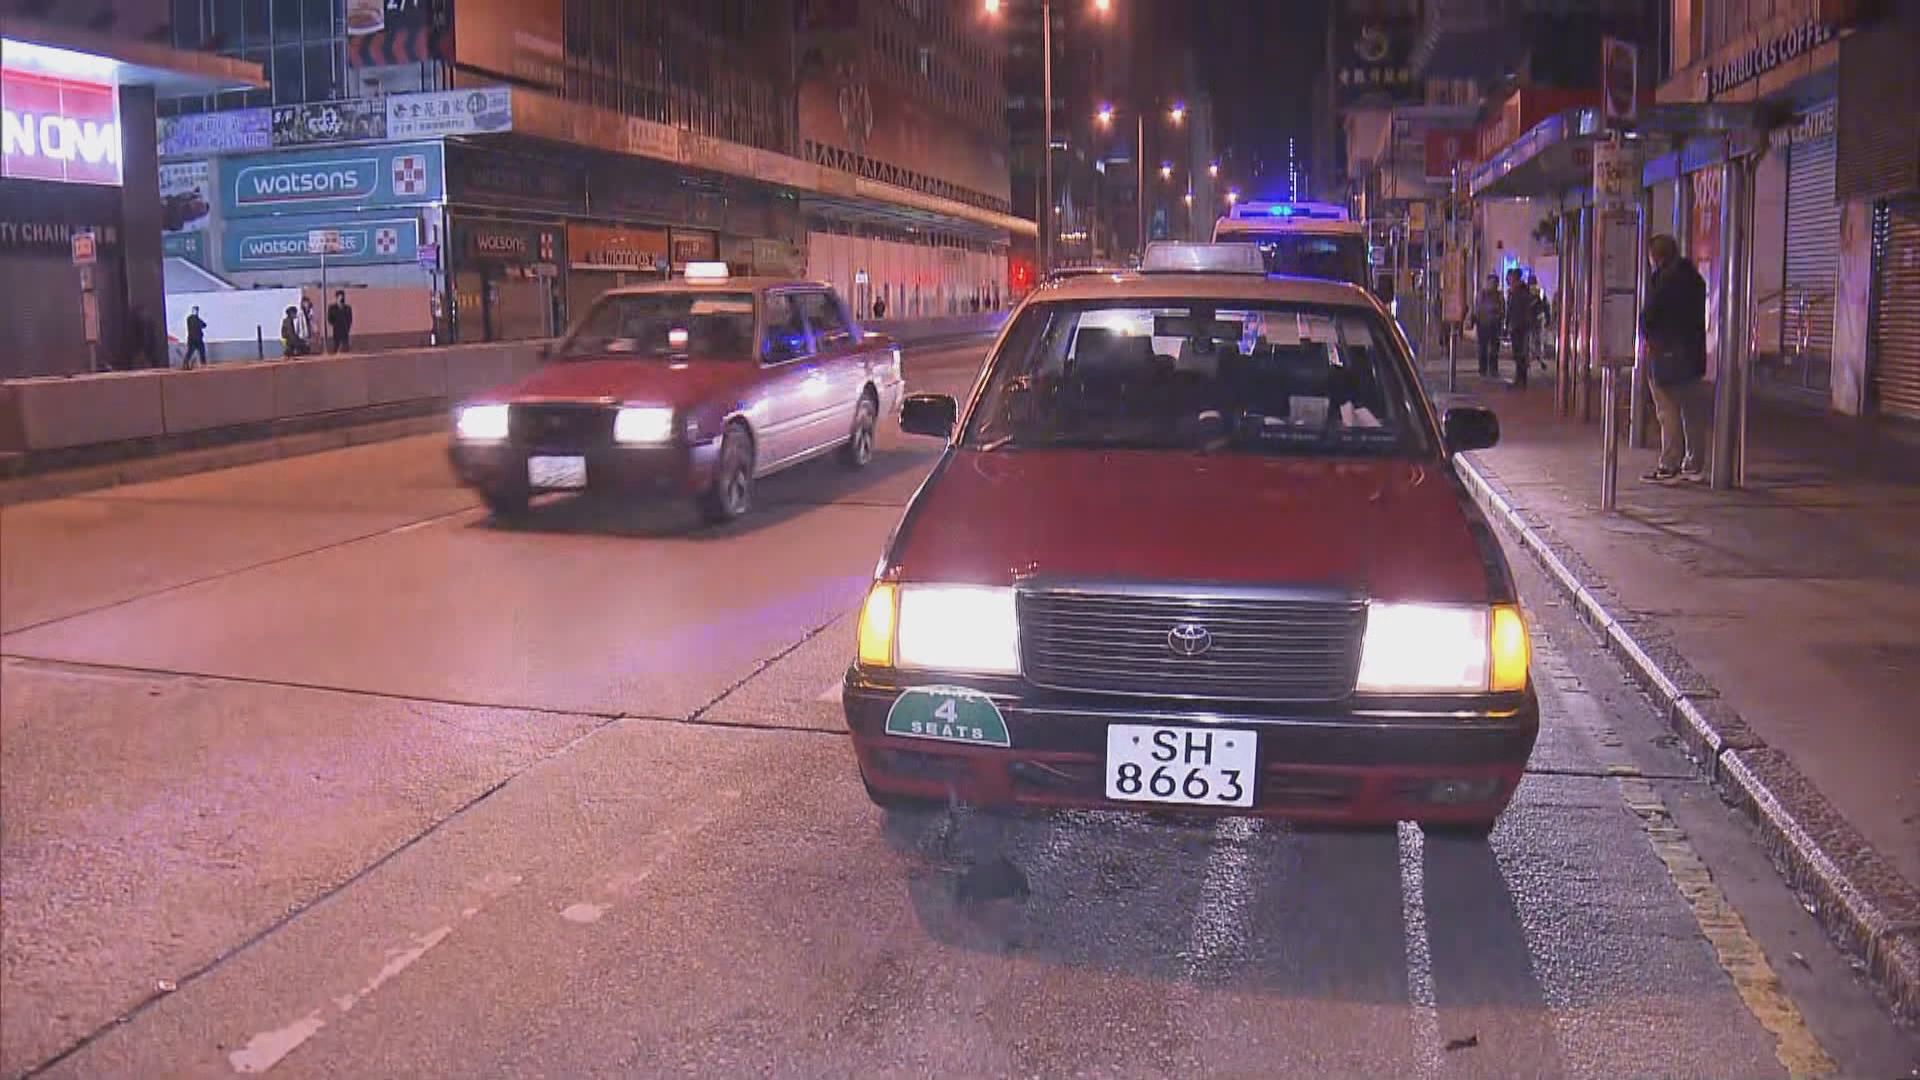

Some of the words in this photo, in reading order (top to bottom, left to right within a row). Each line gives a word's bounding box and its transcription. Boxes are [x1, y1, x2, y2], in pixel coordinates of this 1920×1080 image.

[1711, 41, 1778, 94] STARBUCKS
[253, 169, 358, 194] watsons
[250, 240, 313, 255] watson
[934, 699, 958, 723] 4
[911, 721, 983, 740] SEATS
[1151, 730, 1213, 765] SH
[1116, 762, 1243, 802] 8663
